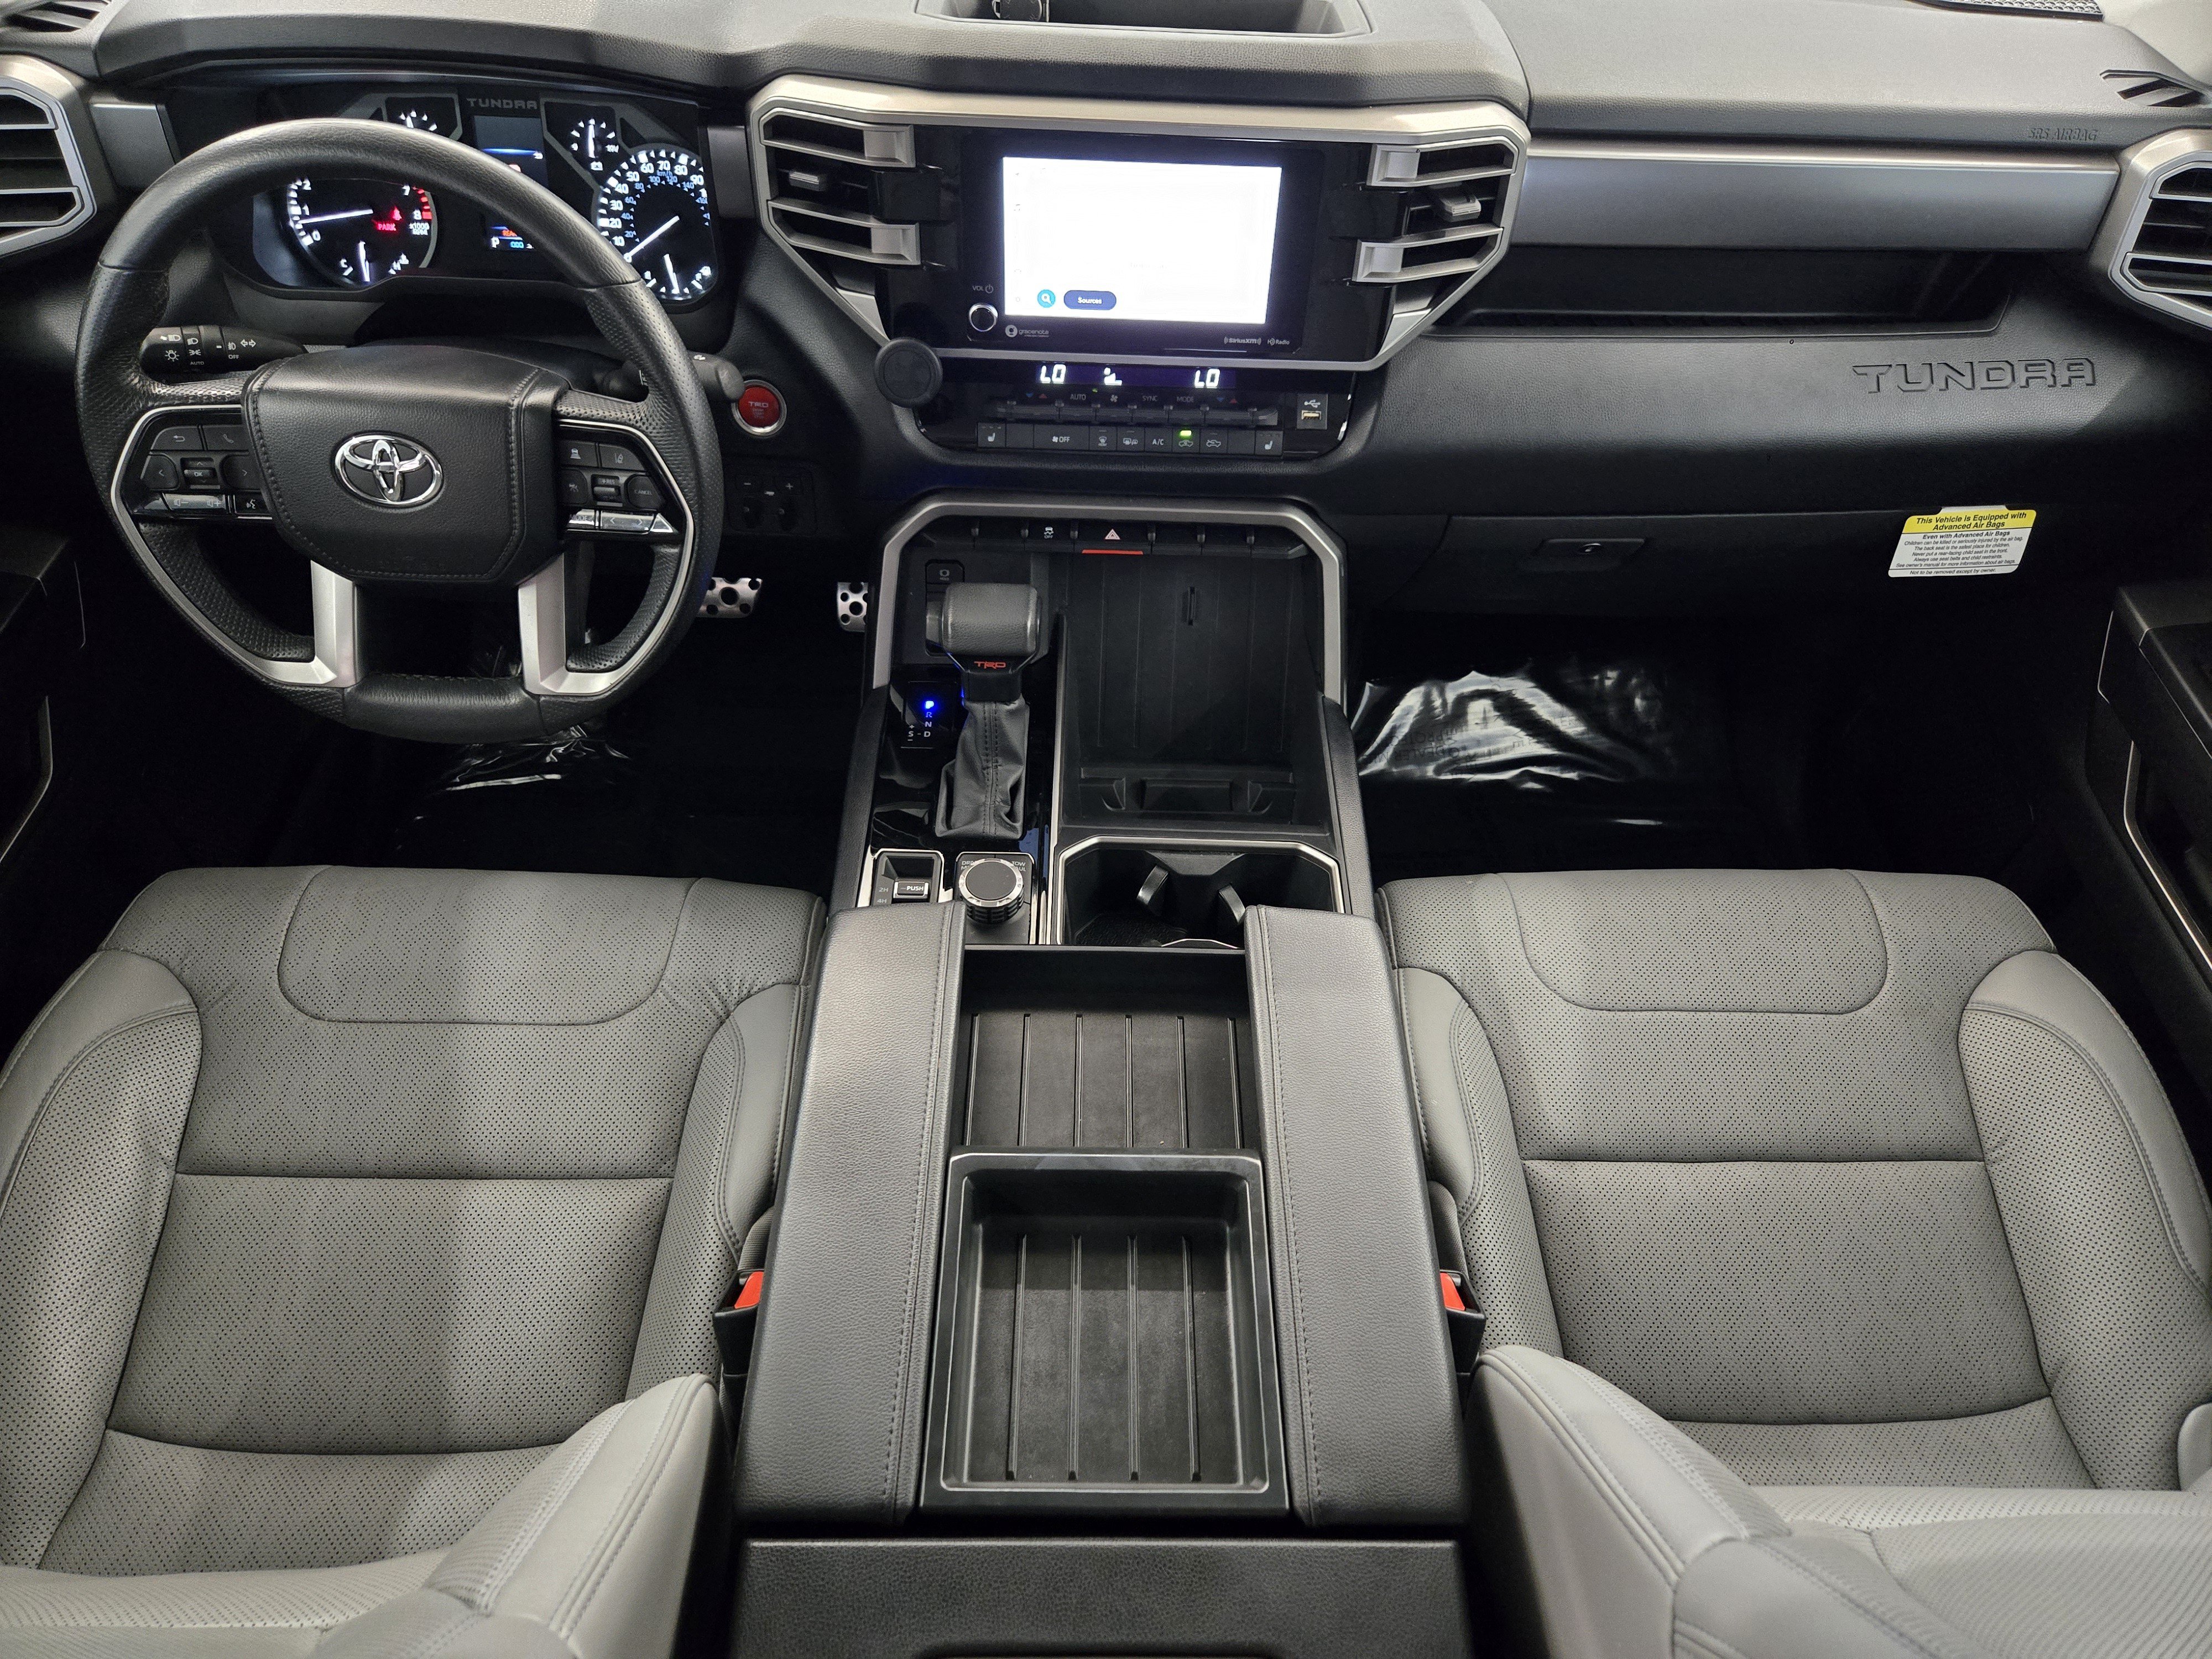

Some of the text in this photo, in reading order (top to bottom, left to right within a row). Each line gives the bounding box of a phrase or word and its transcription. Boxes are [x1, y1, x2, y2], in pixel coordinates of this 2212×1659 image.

[466, 98, 537, 109] TUNDRA
[2028, 128, 2099, 141] SRS AIRBAG
[640, 163, 654, 174] 60
[657, 160, 671, 171] 70
[674, 165, 688, 176] 80
[625, 171, 640, 182] 50
[690, 174, 704, 185] 90
[615, 183, 629, 194] 40
[609, 200, 623, 211] 30
[413, 210, 422, 220] 8
[609, 217, 622, 228] 20
[312, 229, 321, 242] 0
[491, 236, 500, 248] P
[612, 236, 625, 247] 10
[1040, 364, 1066, 384] LO
[1194, 368, 1220, 389] LO
[1852, 358, 2096, 394] TUNDRA
[1973, 513, 2008, 523] Equipped
[1933, 523, 1973, 531] Advanced
[1986, 521, 2005, 530] Bags
[974, 661, 1006, 669] TRD
[925, 700, 935, 709] P
